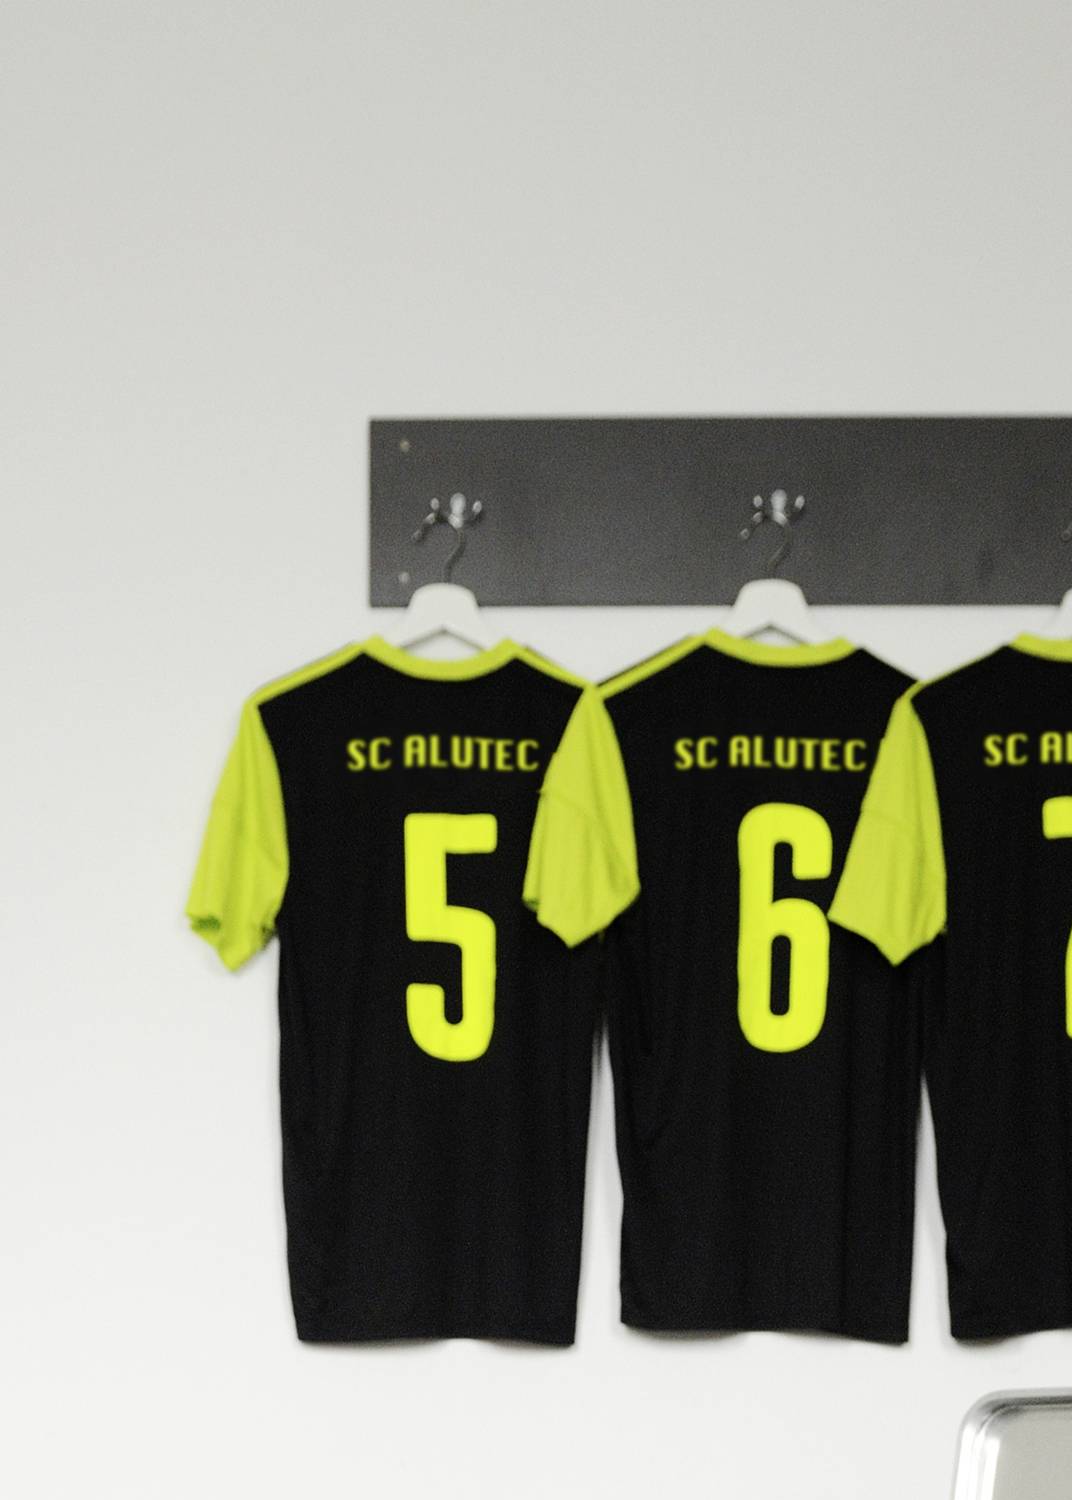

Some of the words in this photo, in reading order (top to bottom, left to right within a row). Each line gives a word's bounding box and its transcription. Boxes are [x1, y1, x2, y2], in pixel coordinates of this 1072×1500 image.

[347, 739, 391, 771] SC
[403, 734, 539, 771] ALUTEC
[674, 737, 718, 770] SC
[729, 737, 867, 771] ALUTEC
[983, 734, 1027, 766] SC
[404, 812, 498, 1063] 5
[737, 802, 833, 1053] 6
